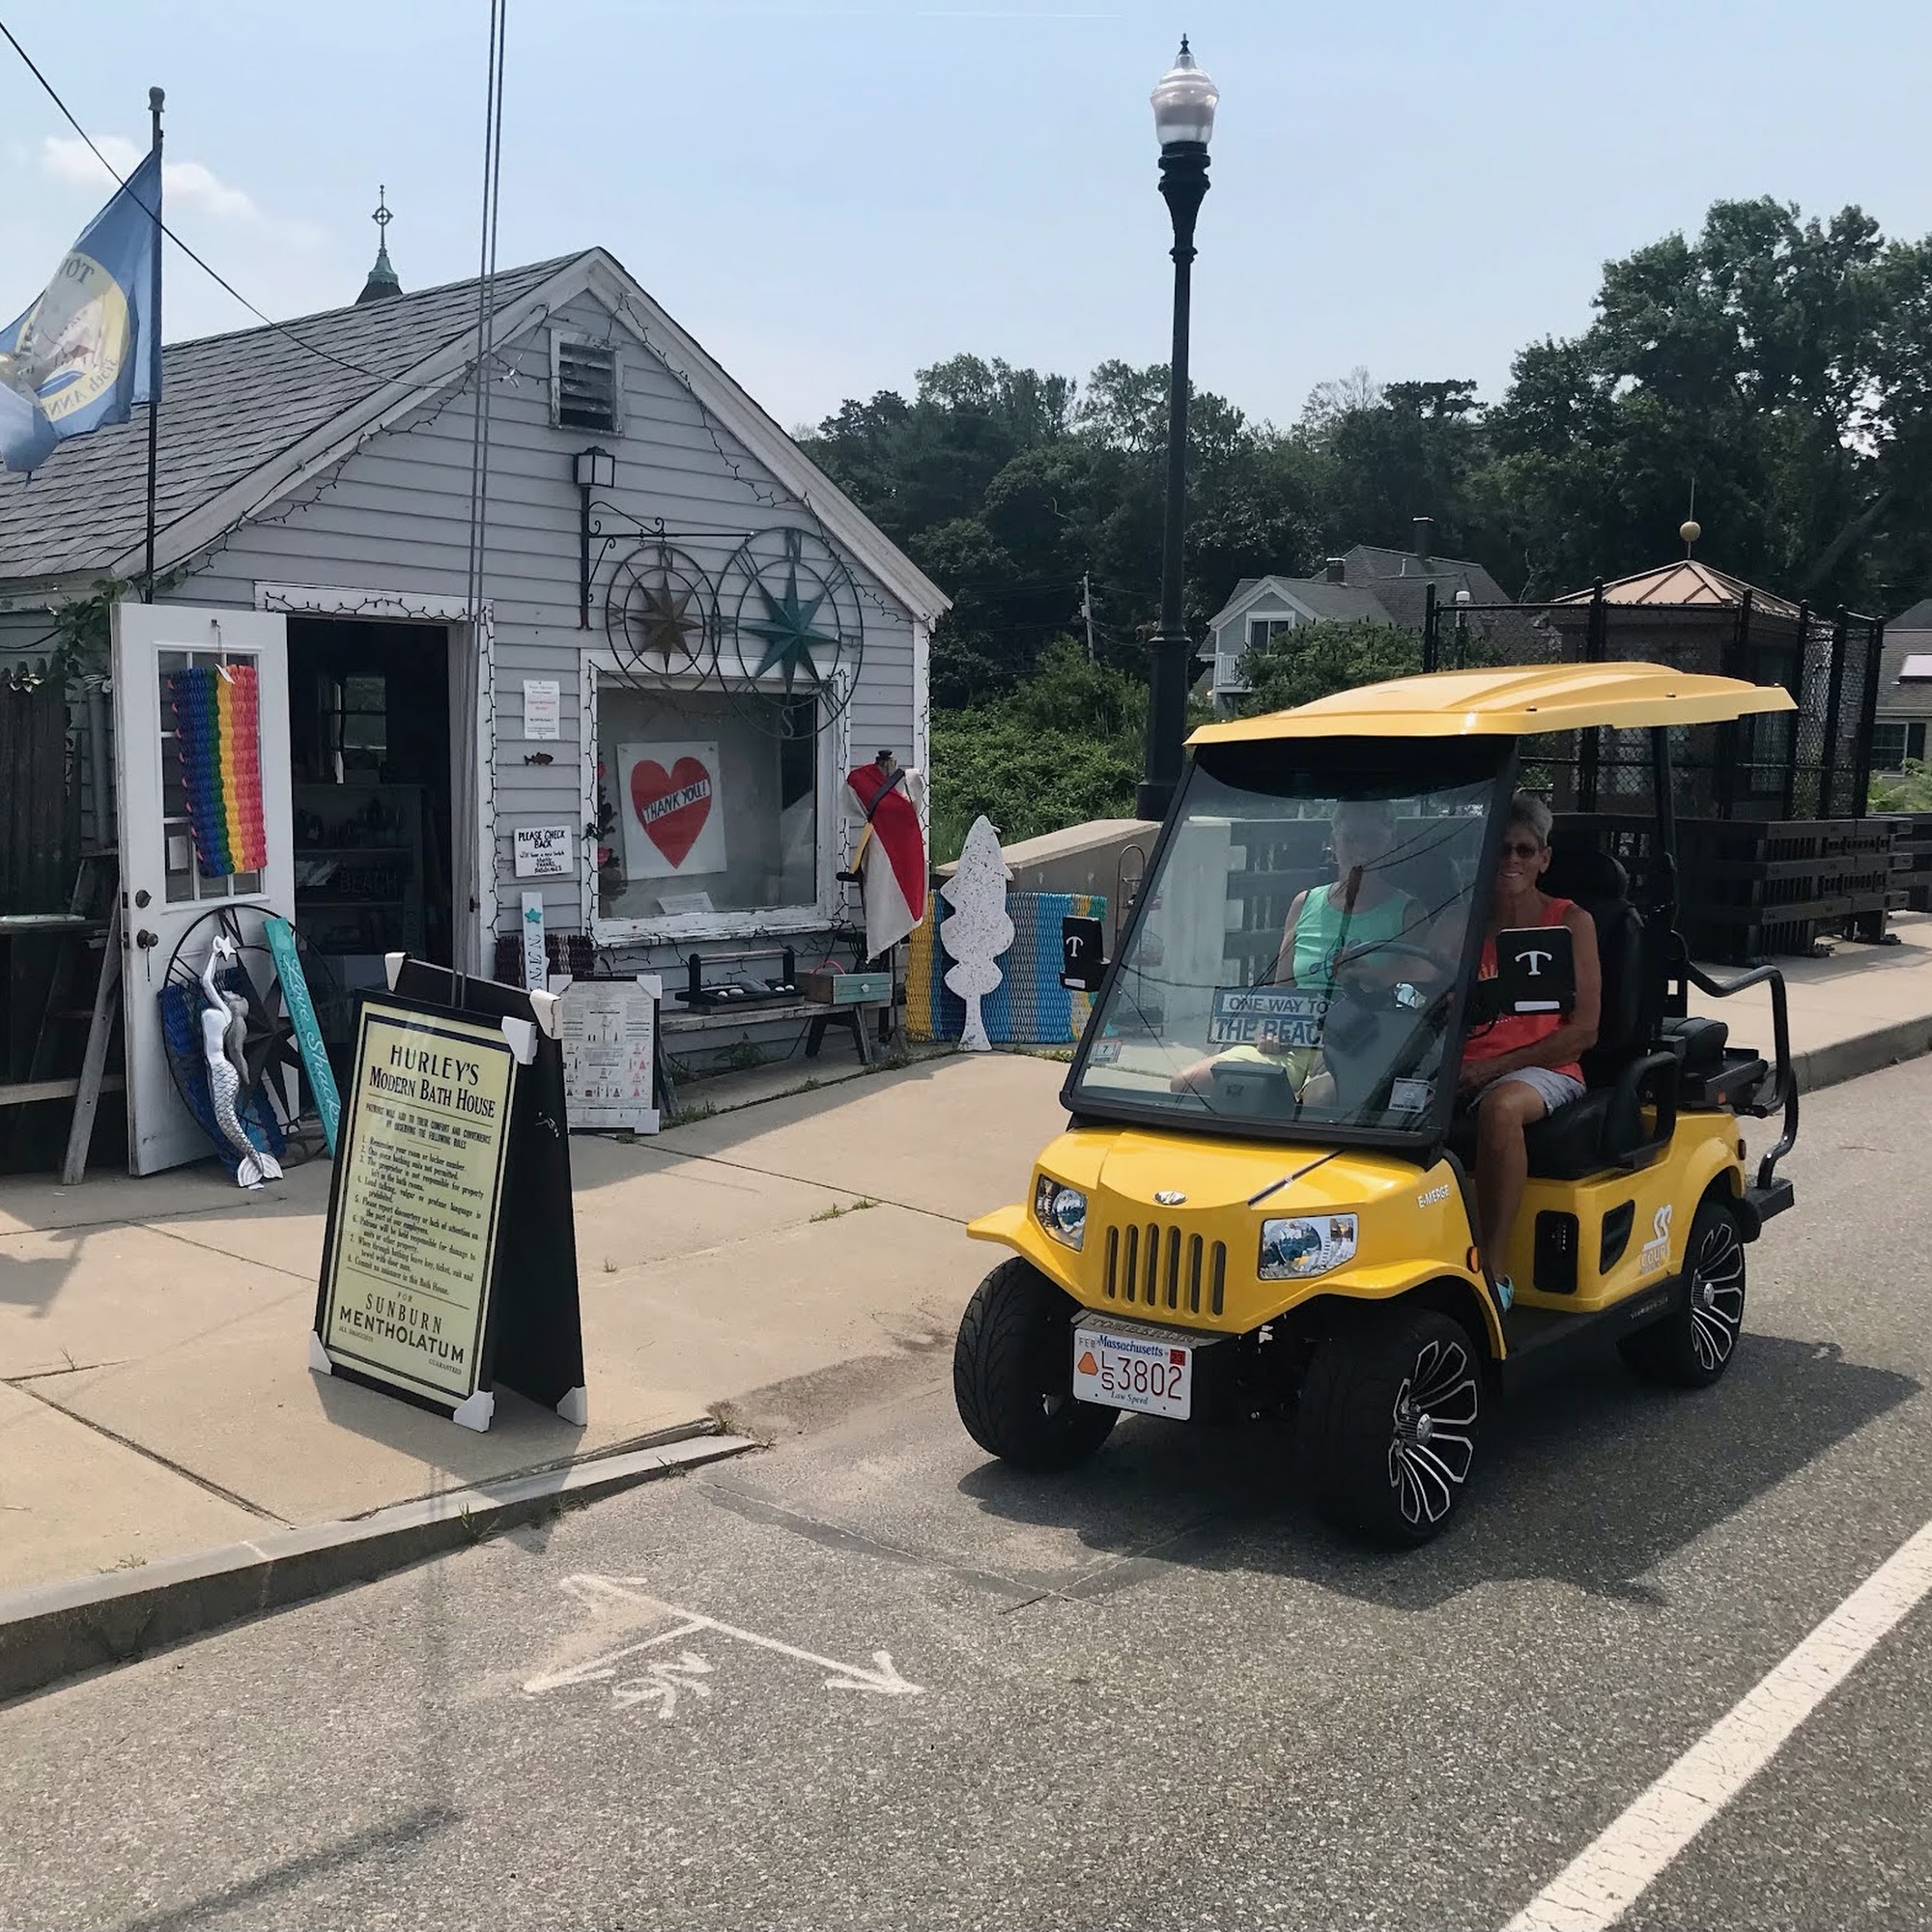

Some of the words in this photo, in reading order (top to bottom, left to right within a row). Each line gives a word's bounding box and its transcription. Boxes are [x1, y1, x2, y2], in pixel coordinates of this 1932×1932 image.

[643, 792, 680, 821] THANK
[681, 781, 707, 804] YOU!
[518, 831, 542, 841] PLEASE
[544, 830, 565, 840] CHECK
[534, 839, 553, 849] BACK
[1229, 997, 1264, 1011] ONE
[1268, 998, 1304, 1013] WAY
[1309, 1000, 1329, 1014] TO
[283, 952, 310, 1023] Love
[306, 1031, 341, 1126] Shack
[1215, 1017, 1258, 1041] THE
[1264, 1019, 1321, 1044] BEAC
[390, 1044, 479, 1086] HURLEY'S
[369, 1065, 416, 1097] MODERN
[419, 1078, 452, 1107] BATH
[456, 1088, 496, 1118] HOUSE
[397, 1292, 412, 1302] FOR
[365, 1293, 441, 1334] SUNBURN
[340, 1306, 464, 1363] MENTHOLATUM
[1078, 1337, 1096, 1349] FEB
[1099, 1335, 1164, 1357] Massachusetts
[428, 1358, 462, 1375] GUARANTEED
[1111, 1391, 1126, 1401] Low
[1127, 1394, 1149, 1406] Speed
